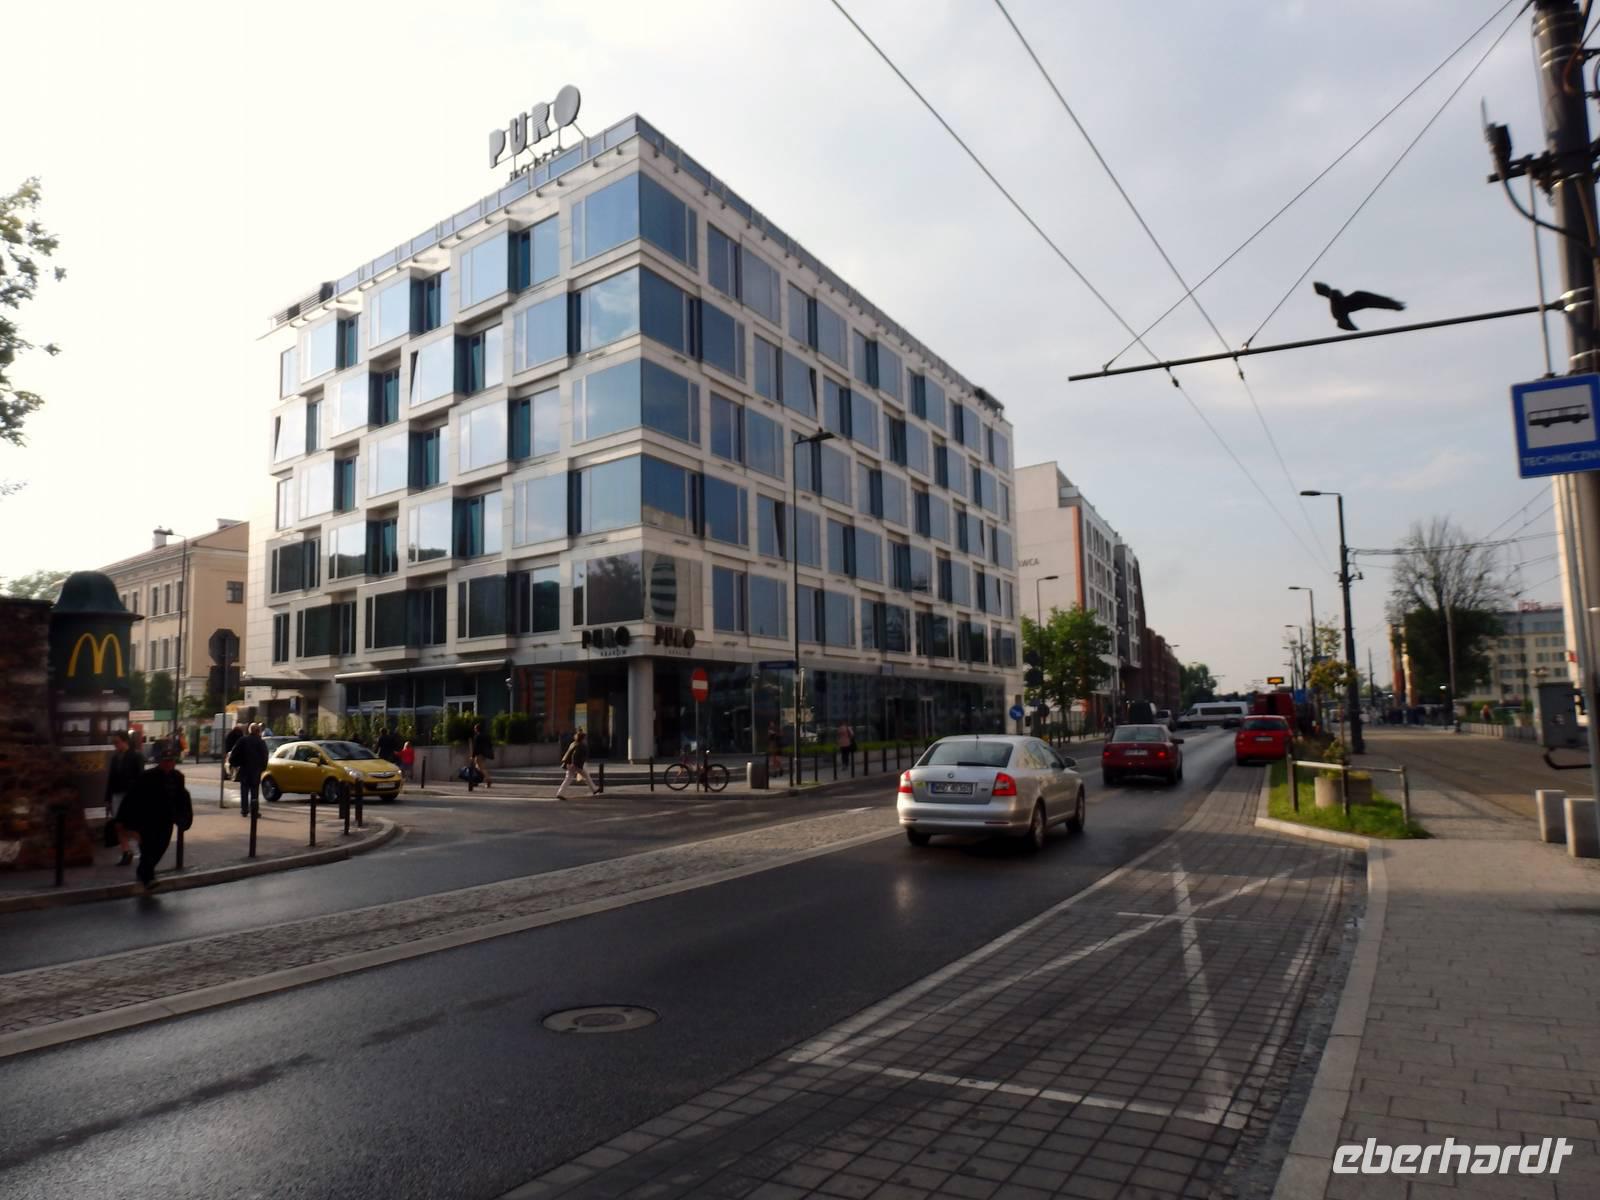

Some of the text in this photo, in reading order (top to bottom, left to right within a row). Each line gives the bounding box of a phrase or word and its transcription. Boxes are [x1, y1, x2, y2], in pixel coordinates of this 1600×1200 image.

[488, 84, 581, 169] PURO
[1521, 450, 1600, 466] TECHNICZN
[582, 626, 631, 649] PURO
[654, 625, 696, 648] PURO
